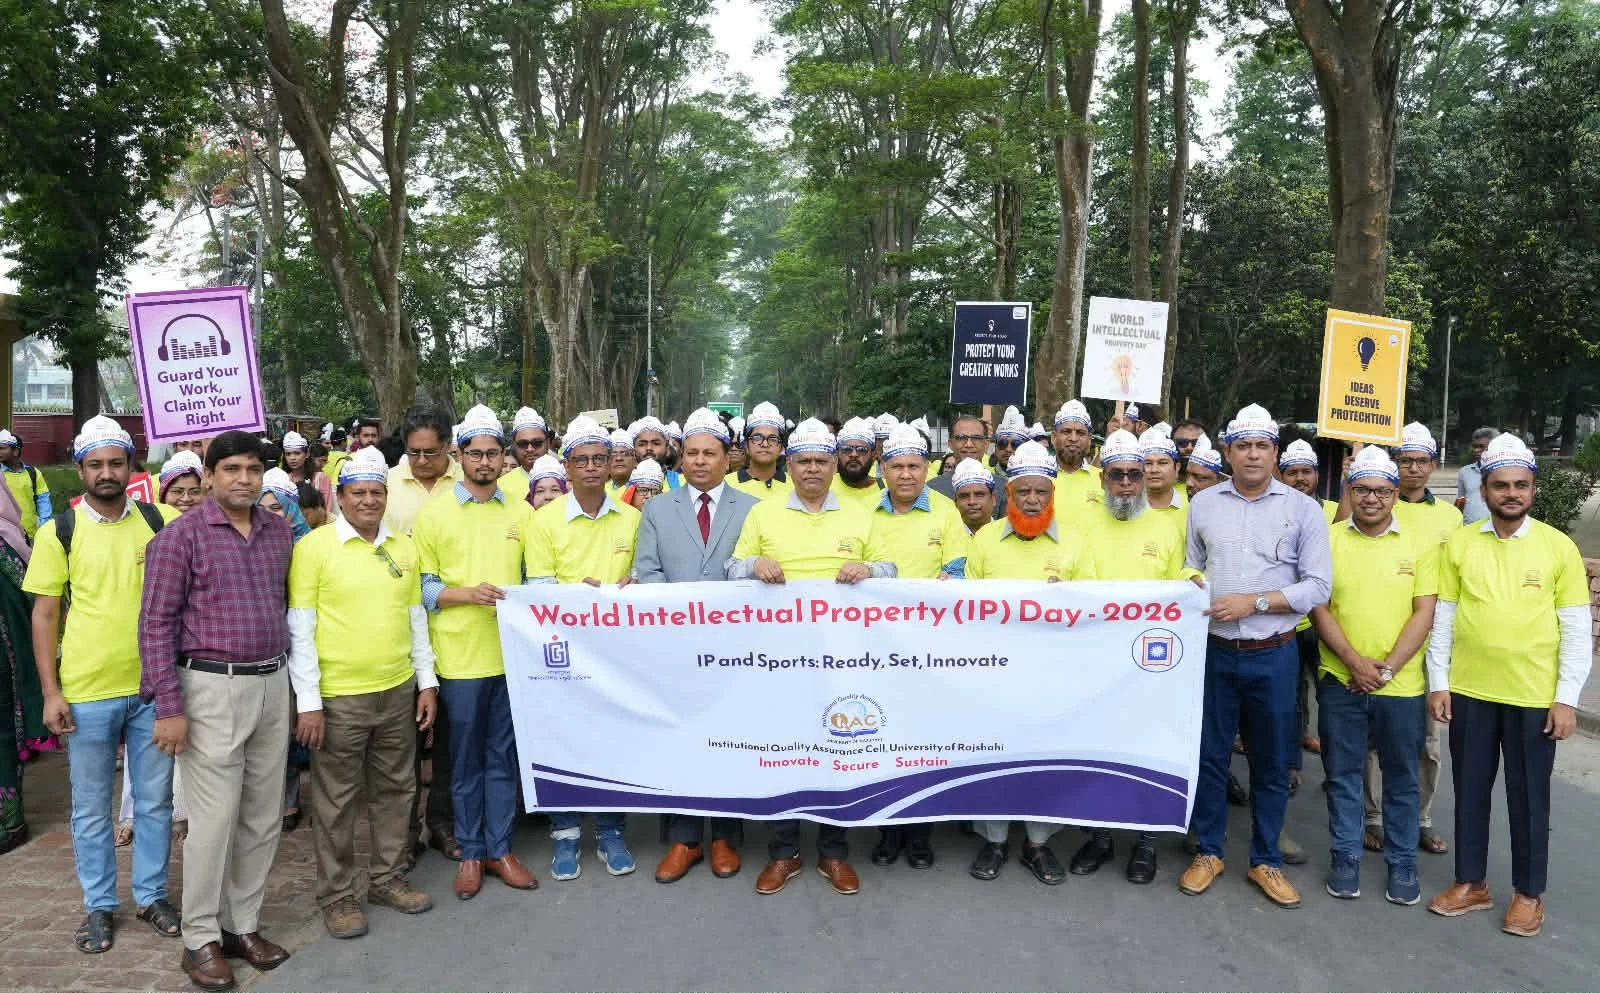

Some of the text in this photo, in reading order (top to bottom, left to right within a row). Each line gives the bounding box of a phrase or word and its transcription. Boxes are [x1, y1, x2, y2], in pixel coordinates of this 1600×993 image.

[1110, 313, 1145, 325] WORLD
[965, 344, 1016, 358] PROTECT YOUR
[157, 366, 240, 384] Guard Your
[959, 362, 1019, 378] CREATIVE WORKS
[178, 382, 222, 396] Work,
[1350, 382, 1374, 395] IDEAS
[164, 396, 242, 412] Claim Your
[1344, 394, 1380, 410] DESERVE
[186, 411, 226, 426] Right
[1330, 408, 1392, 426] PROTECHTION
[530, 602, 620, 627] World
[626, 598, 803, 627] Intellectual
[810, 599, 947, 628] Property
[953, 599, 1011, 625] (IP)
[1019, 599, 1082, 627] Day
[1103, 601, 1182, 622] 2026
[697, 651, 1009, 672] IP and Sports: Ready, Set, Innovate
[708, 738, 769, 752] Institutional
[770, 742, 811, 754] Quality
[812, 744, 863, 756] Assurance
[889, 742, 944, 754] University
[944, 742, 956, 752] of
[957, 742, 1004, 754] Rajshahi
[759, 757, 948, 772] Innovate Secure Sustain
